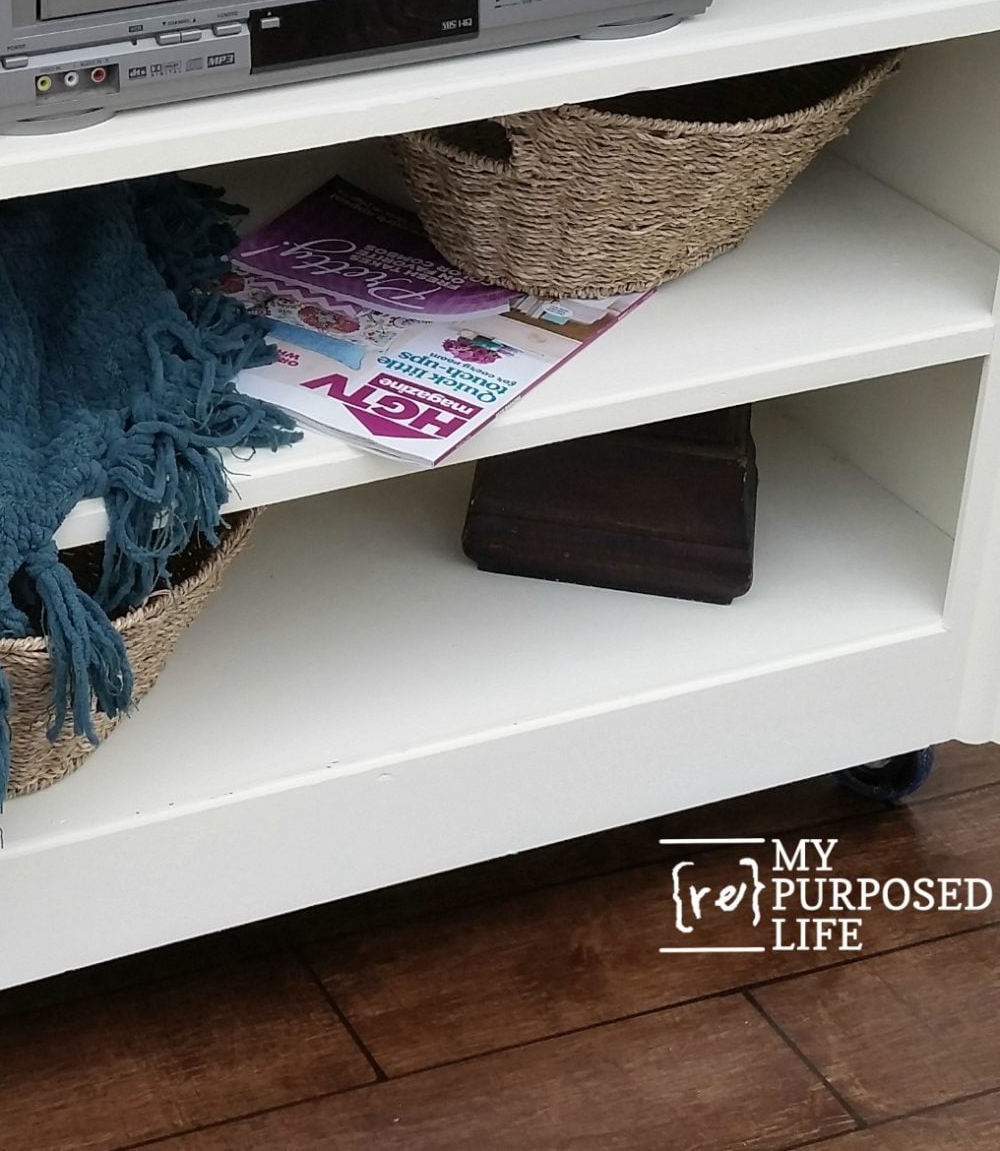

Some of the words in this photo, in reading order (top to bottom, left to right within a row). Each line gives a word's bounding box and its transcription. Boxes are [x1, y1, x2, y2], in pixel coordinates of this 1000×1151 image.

[208, 55, 234, 66] MP3
[349, 254, 401, 274] TAKES
[354, 248, 438, 277] FAVORITE
[361, 244, 435, 269] COMBOS
[240, 238, 443, 310] Pretty!
[406, 269, 461, 290] FRESH
[438, 270, 466, 284] ON
[376, 355, 429, 381] little
[396, 350, 509, 396] touch-ups
[377, 376, 475, 416] magazine
[430, 371, 497, 404] Quick
[300, 372, 468, 439] HGTV
